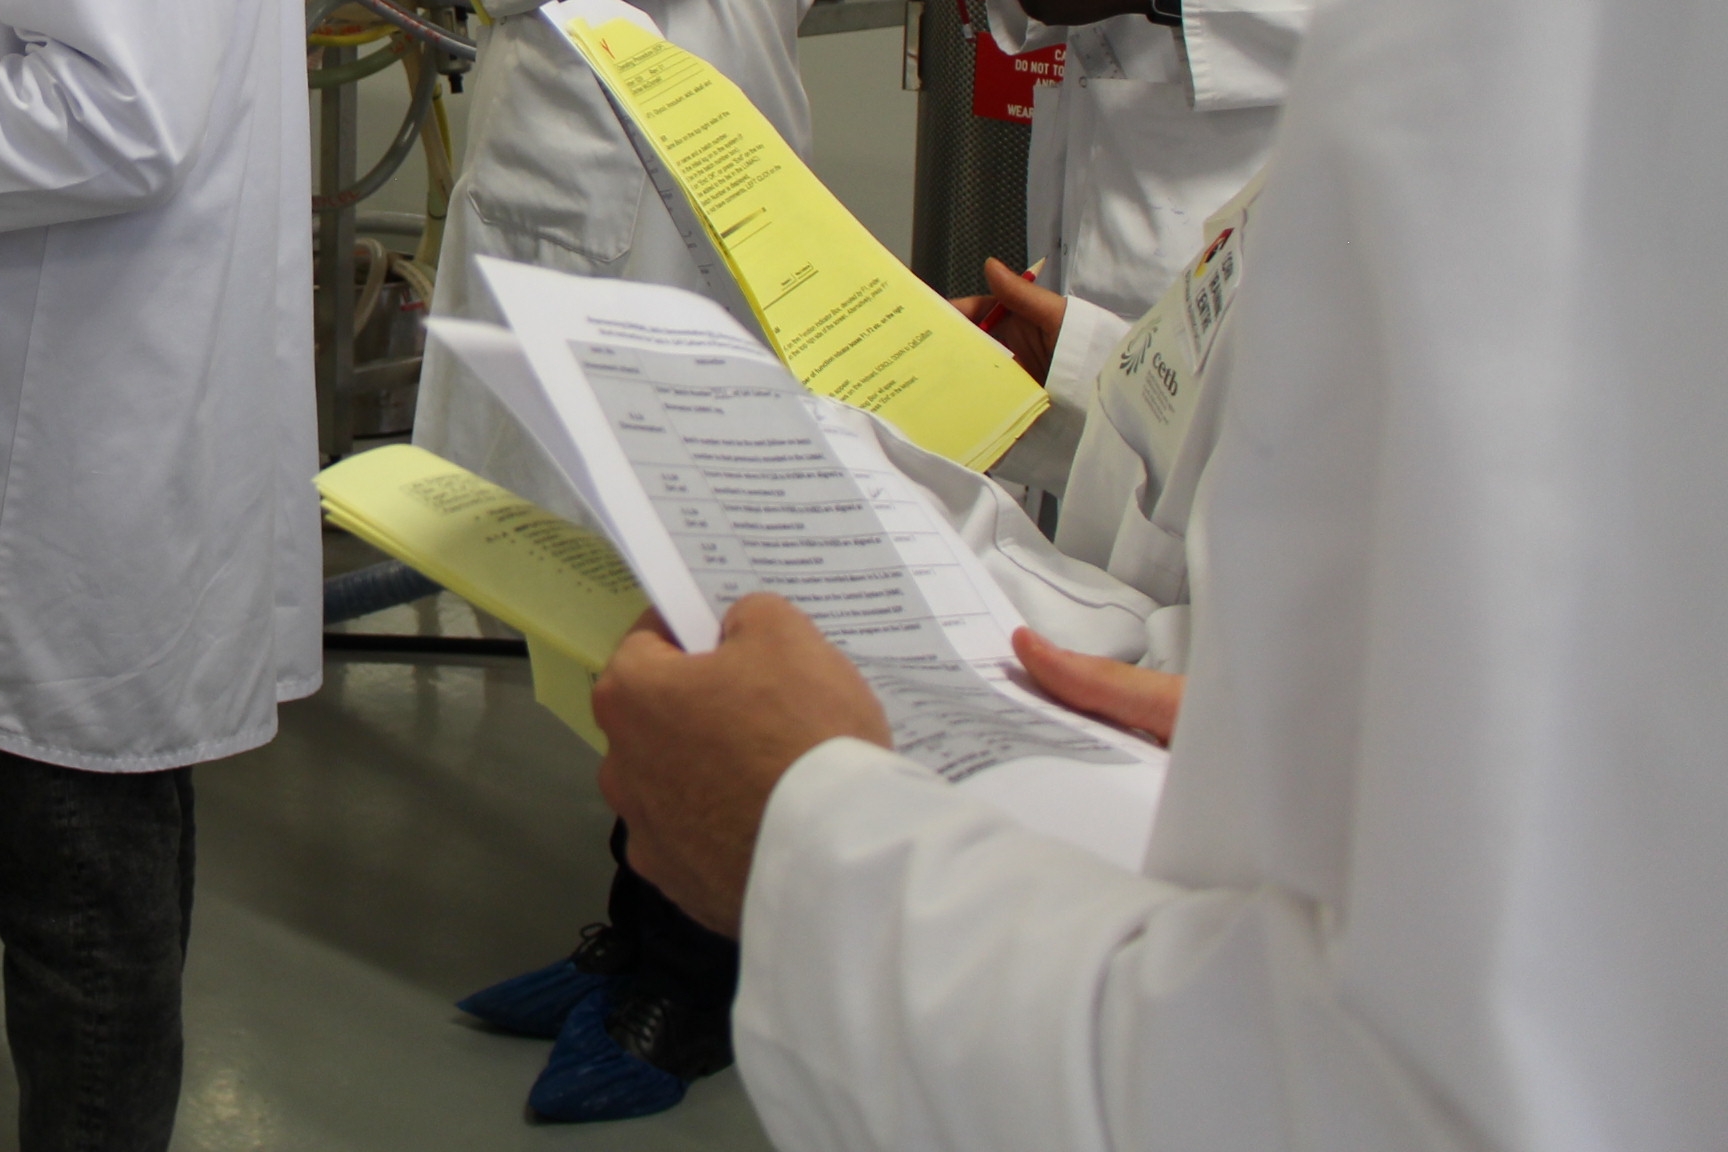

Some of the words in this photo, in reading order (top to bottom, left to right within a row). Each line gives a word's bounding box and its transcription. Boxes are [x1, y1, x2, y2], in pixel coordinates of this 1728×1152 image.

[1055, 50, 1066, 60] CA
[1015, 59, 1028, 71] DO
[1031, 62, 1049, 74] NOT
[1053, 64, 1064, 76] TO
[745, 178, 757, 189] LEFT
[814, 356, 835, 374] function
[1152, 352, 1178, 396] cetb
